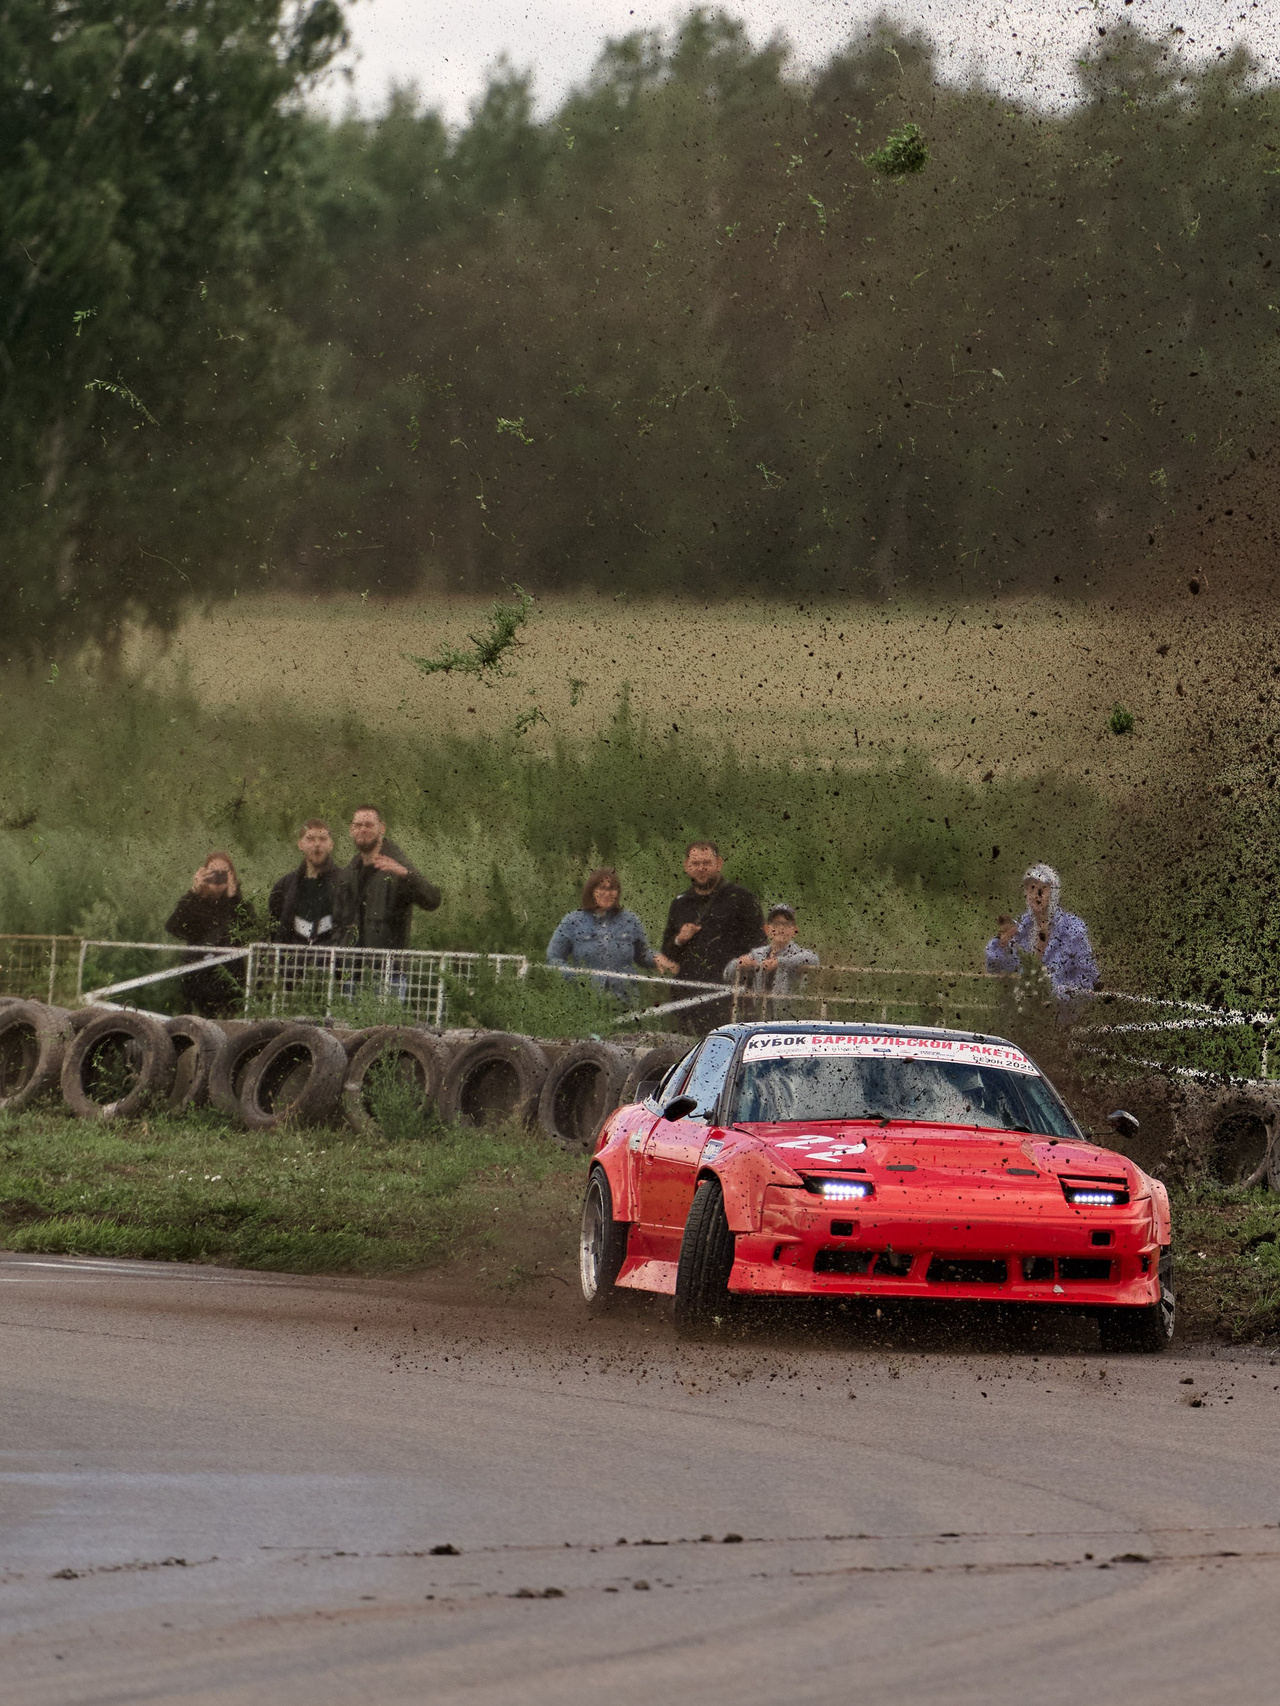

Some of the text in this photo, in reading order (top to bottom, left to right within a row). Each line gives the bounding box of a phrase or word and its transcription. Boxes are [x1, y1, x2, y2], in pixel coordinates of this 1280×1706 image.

[749, 1036, 806, 1049] КУБОК
[959, 1043, 1028, 1063] РАКЕТЫ
[972, 1056, 1035, 1072] СЕЗОН 2025
